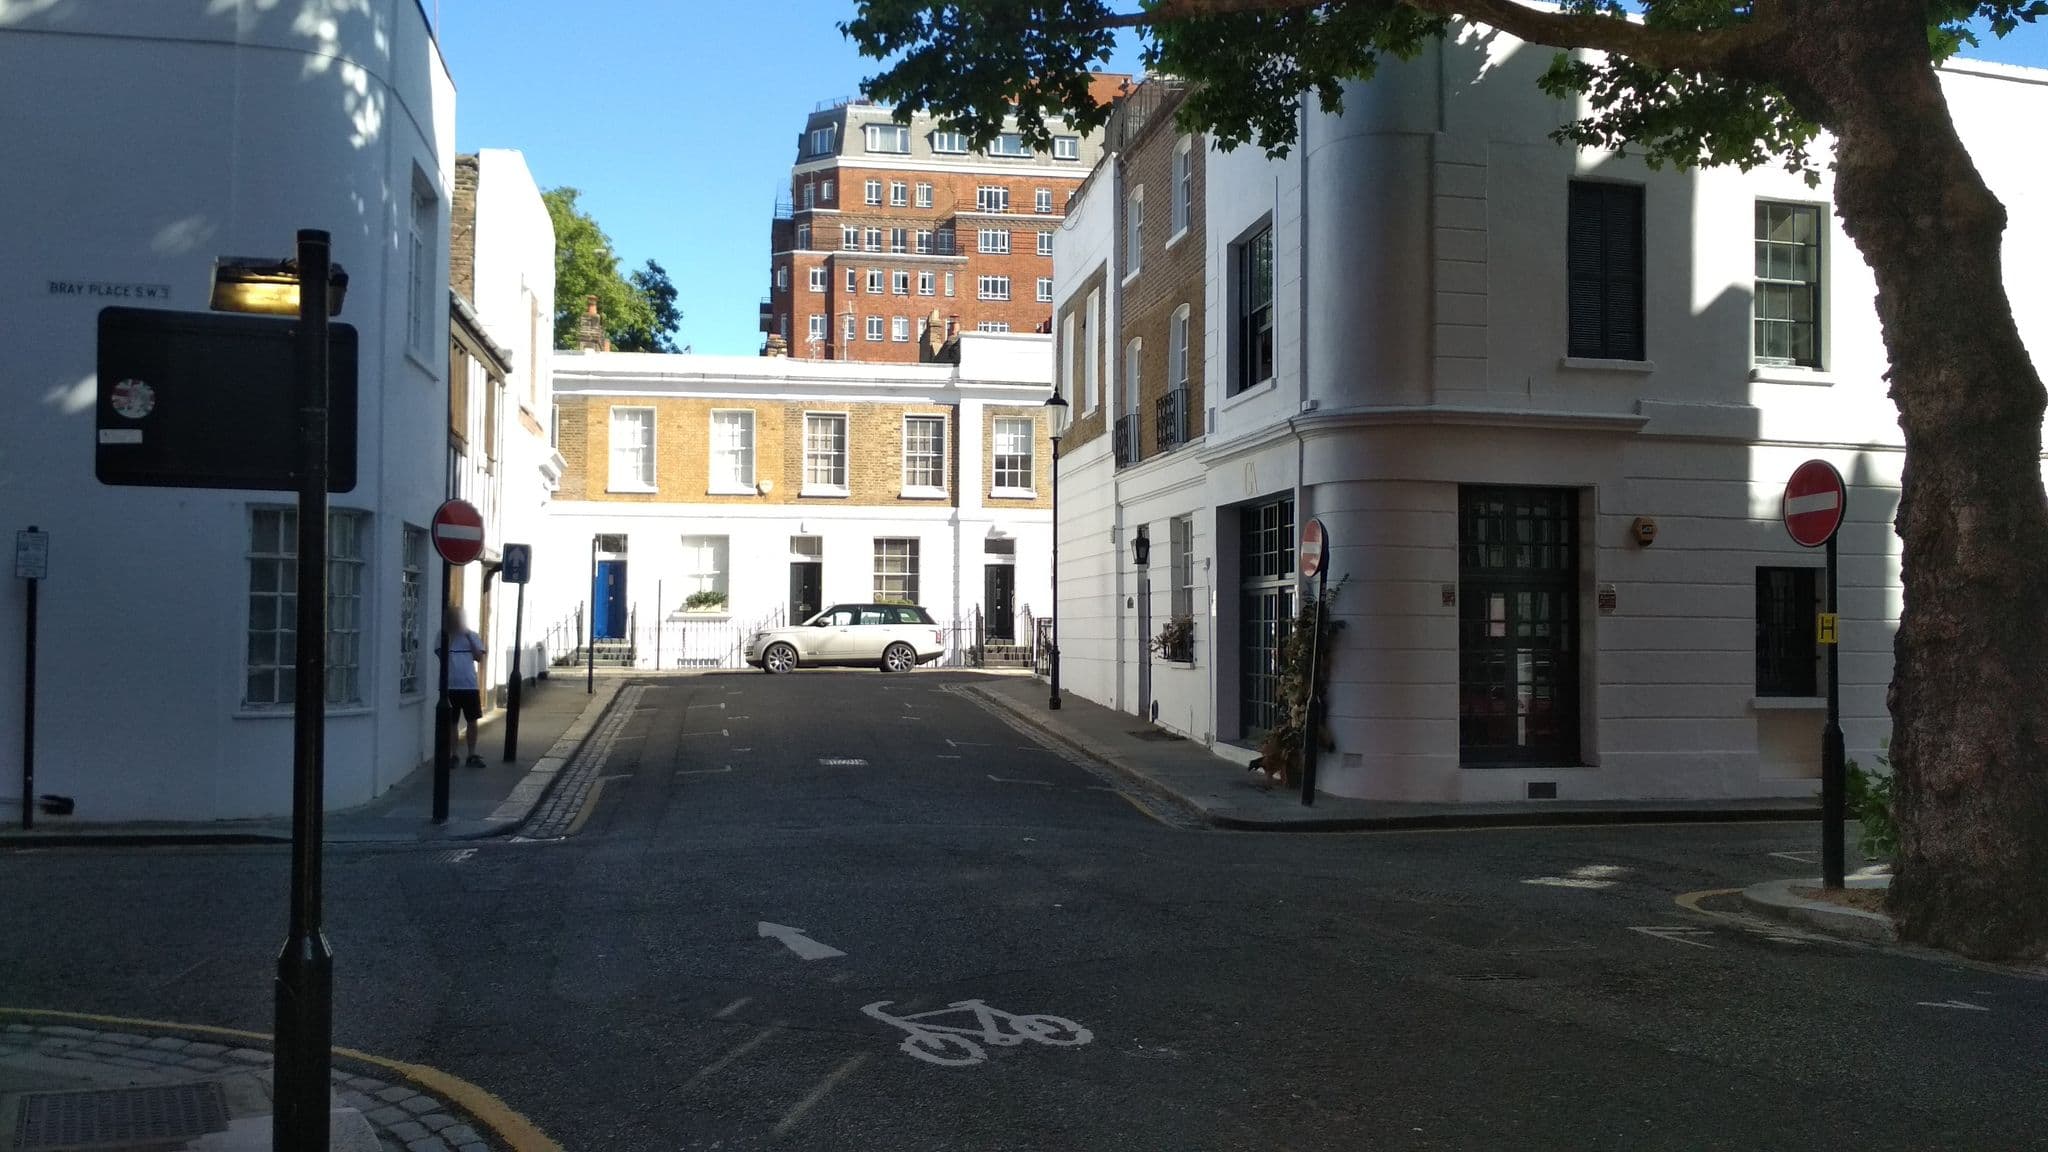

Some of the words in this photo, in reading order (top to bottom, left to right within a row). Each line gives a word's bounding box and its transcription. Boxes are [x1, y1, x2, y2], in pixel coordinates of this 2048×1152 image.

[50, 281, 84, 295] BRAY
[89, 284, 130, 297] PLACE
[1821, 616, 1835, 640] H
